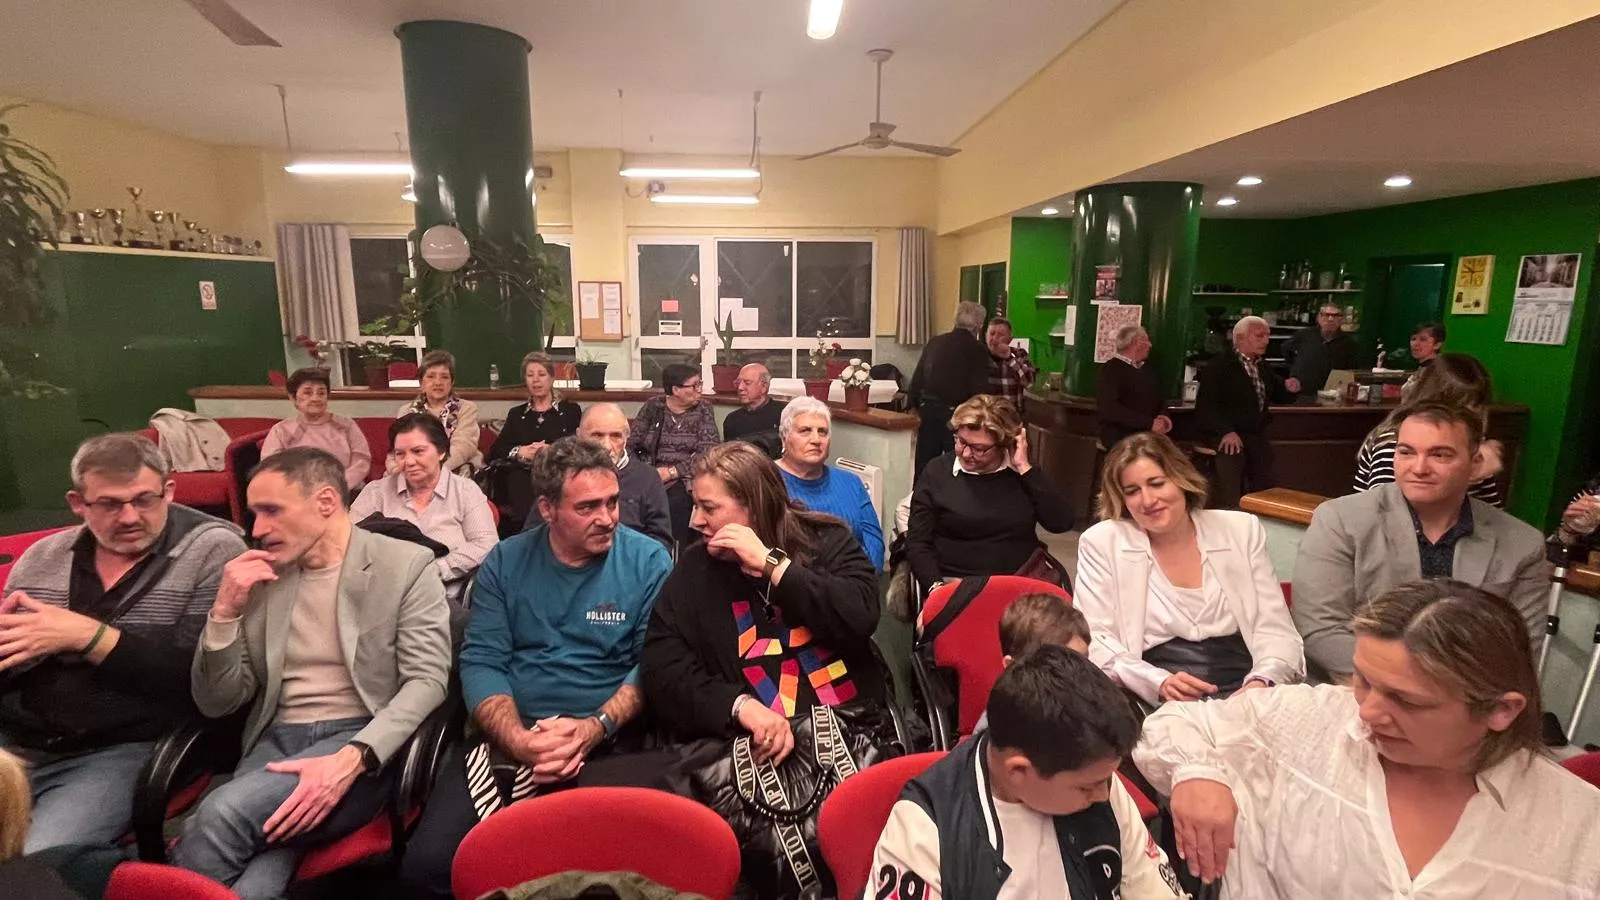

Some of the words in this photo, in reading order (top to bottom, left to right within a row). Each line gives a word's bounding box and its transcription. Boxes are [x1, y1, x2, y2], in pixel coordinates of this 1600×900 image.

[586, 611, 626, 621] HOLLISTER
[815, 705, 829, 727] YOU
[817, 732, 832, 748] UP
[736, 738, 749, 767] YOU
[740, 768, 753, 787] TO
[761, 771, 777, 789] TO
[767, 790, 783, 806] UP
[786, 836, 803, 858] TO
[795, 861, 813, 881] UP
